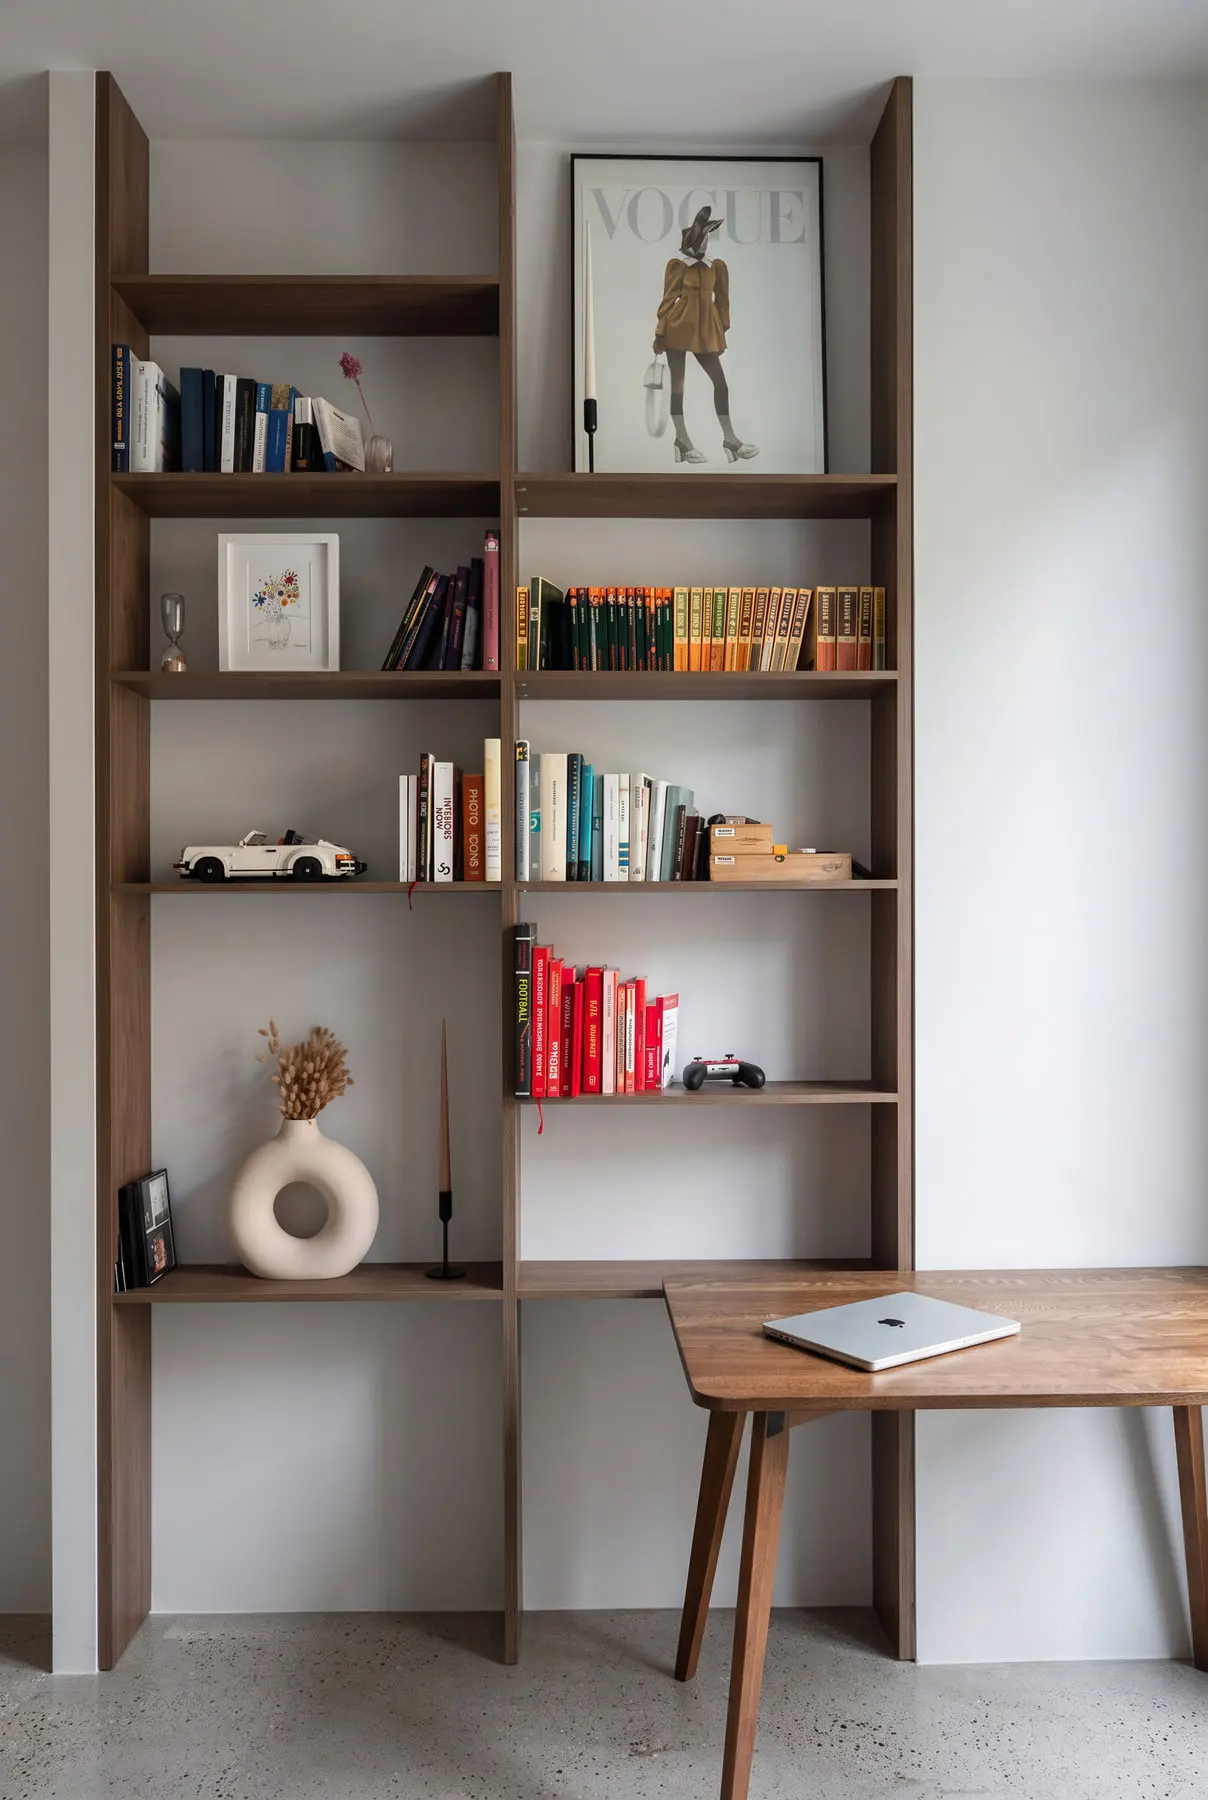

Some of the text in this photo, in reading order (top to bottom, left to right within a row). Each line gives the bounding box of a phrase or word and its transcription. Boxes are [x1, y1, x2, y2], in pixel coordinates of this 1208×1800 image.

[587, 187, 805, 244] VOGUE
[469, 789, 479, 868] PHOTO ICONS
[518, 979, 528, 1023] FOOTBALL
